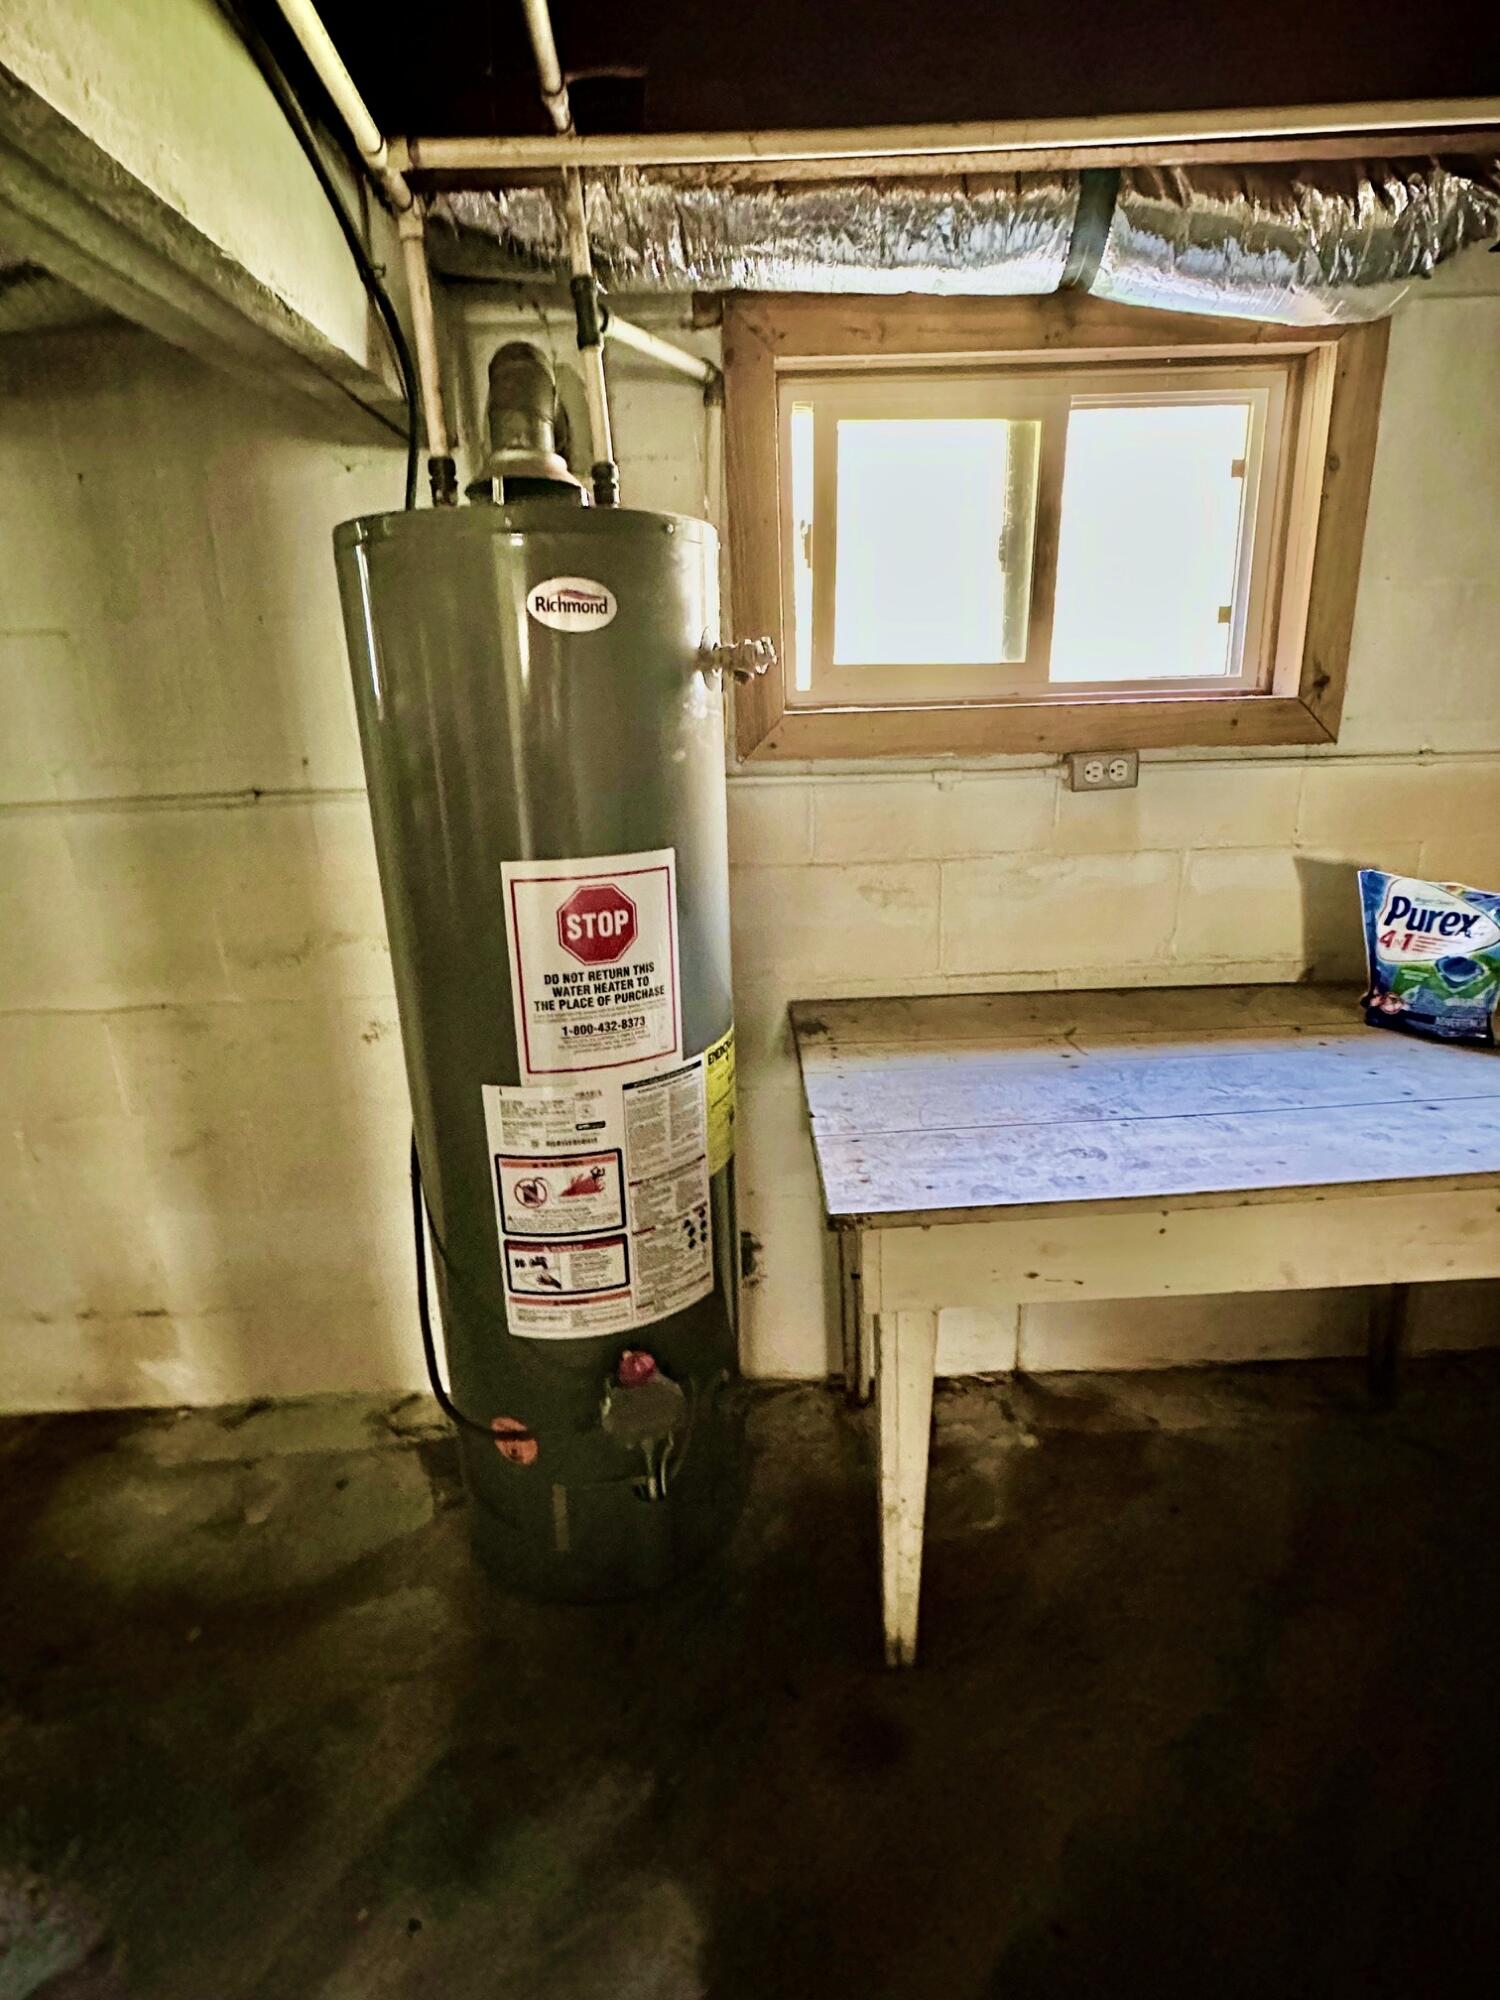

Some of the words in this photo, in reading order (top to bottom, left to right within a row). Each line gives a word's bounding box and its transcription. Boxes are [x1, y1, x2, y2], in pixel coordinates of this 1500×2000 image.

[535, 595, 608, 614] Richmond
[566, 909, 629, 941] STOP
[1384, 896, 1480, 936] Purex
[544, 974, 559, 985] DO
[562, 972, 585, 984] NOT
[588, 966, 630, 981] RETURN
[633, 962, 655, 975] THIS
[534, 1001, 555, 1012] THE
[559, 997, 594, 1010] PLACE
[597, 995, 611, 1007] OF
[614, 985, 665, 1004] PURCHASE
[552, 985, 591, 998] WATER
[594, 978, 634, 993] HEATER
[637, 976, 650, 987] TO
[562, 1016, 646, 1036] 1-800-432-8373
